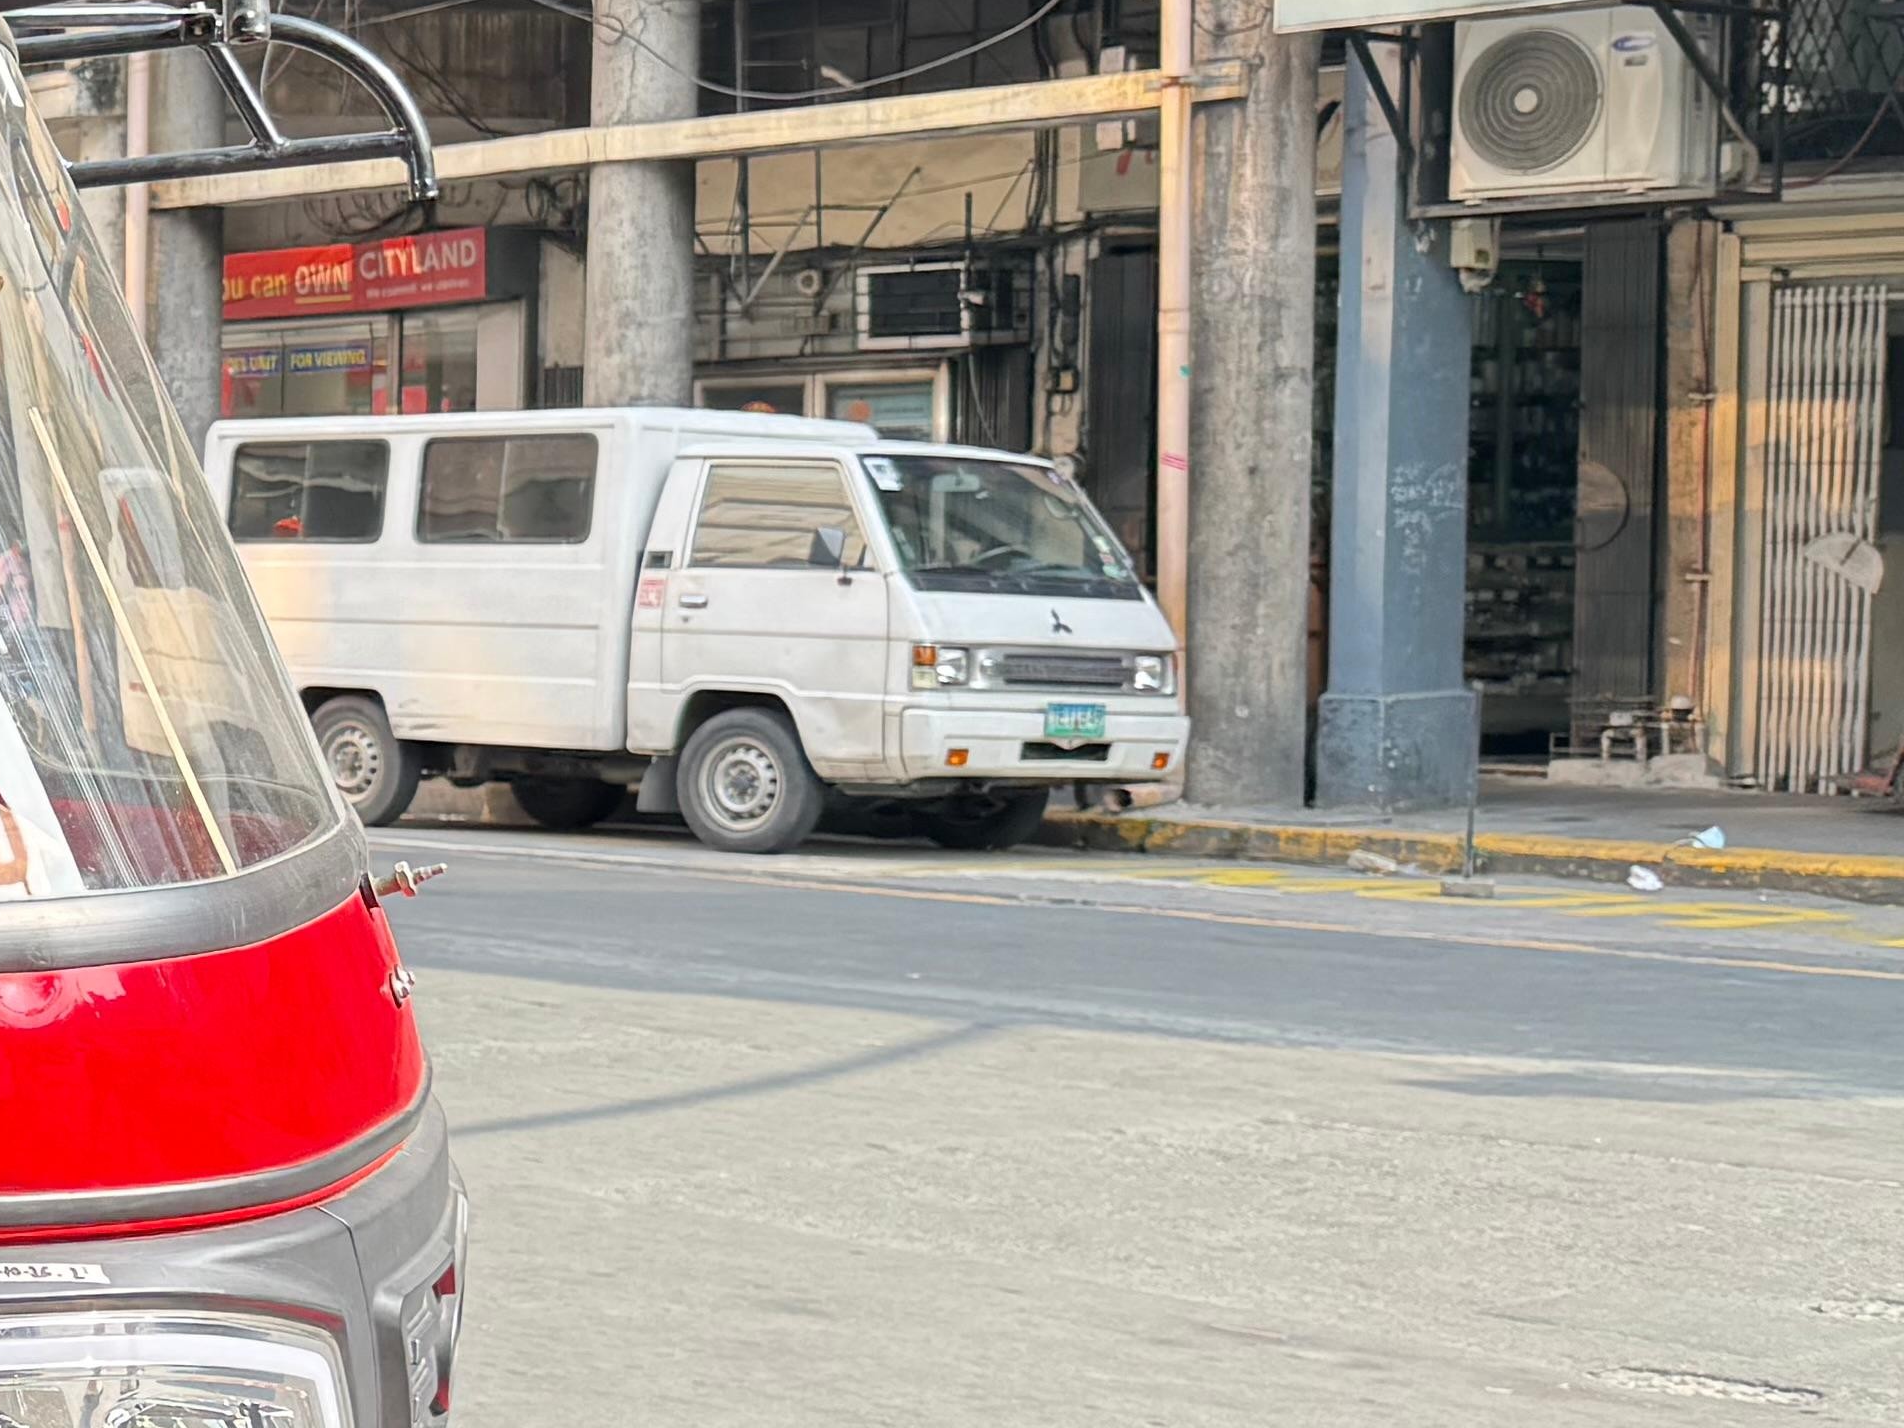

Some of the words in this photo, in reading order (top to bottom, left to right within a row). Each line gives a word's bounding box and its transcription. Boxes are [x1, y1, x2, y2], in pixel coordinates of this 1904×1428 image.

[359, 238, 478, 280] CITYLAND
[251, 273, 288, 298] can
[295, 262, 351, 296] OWN
[290, 353, 313, 369] FOR
